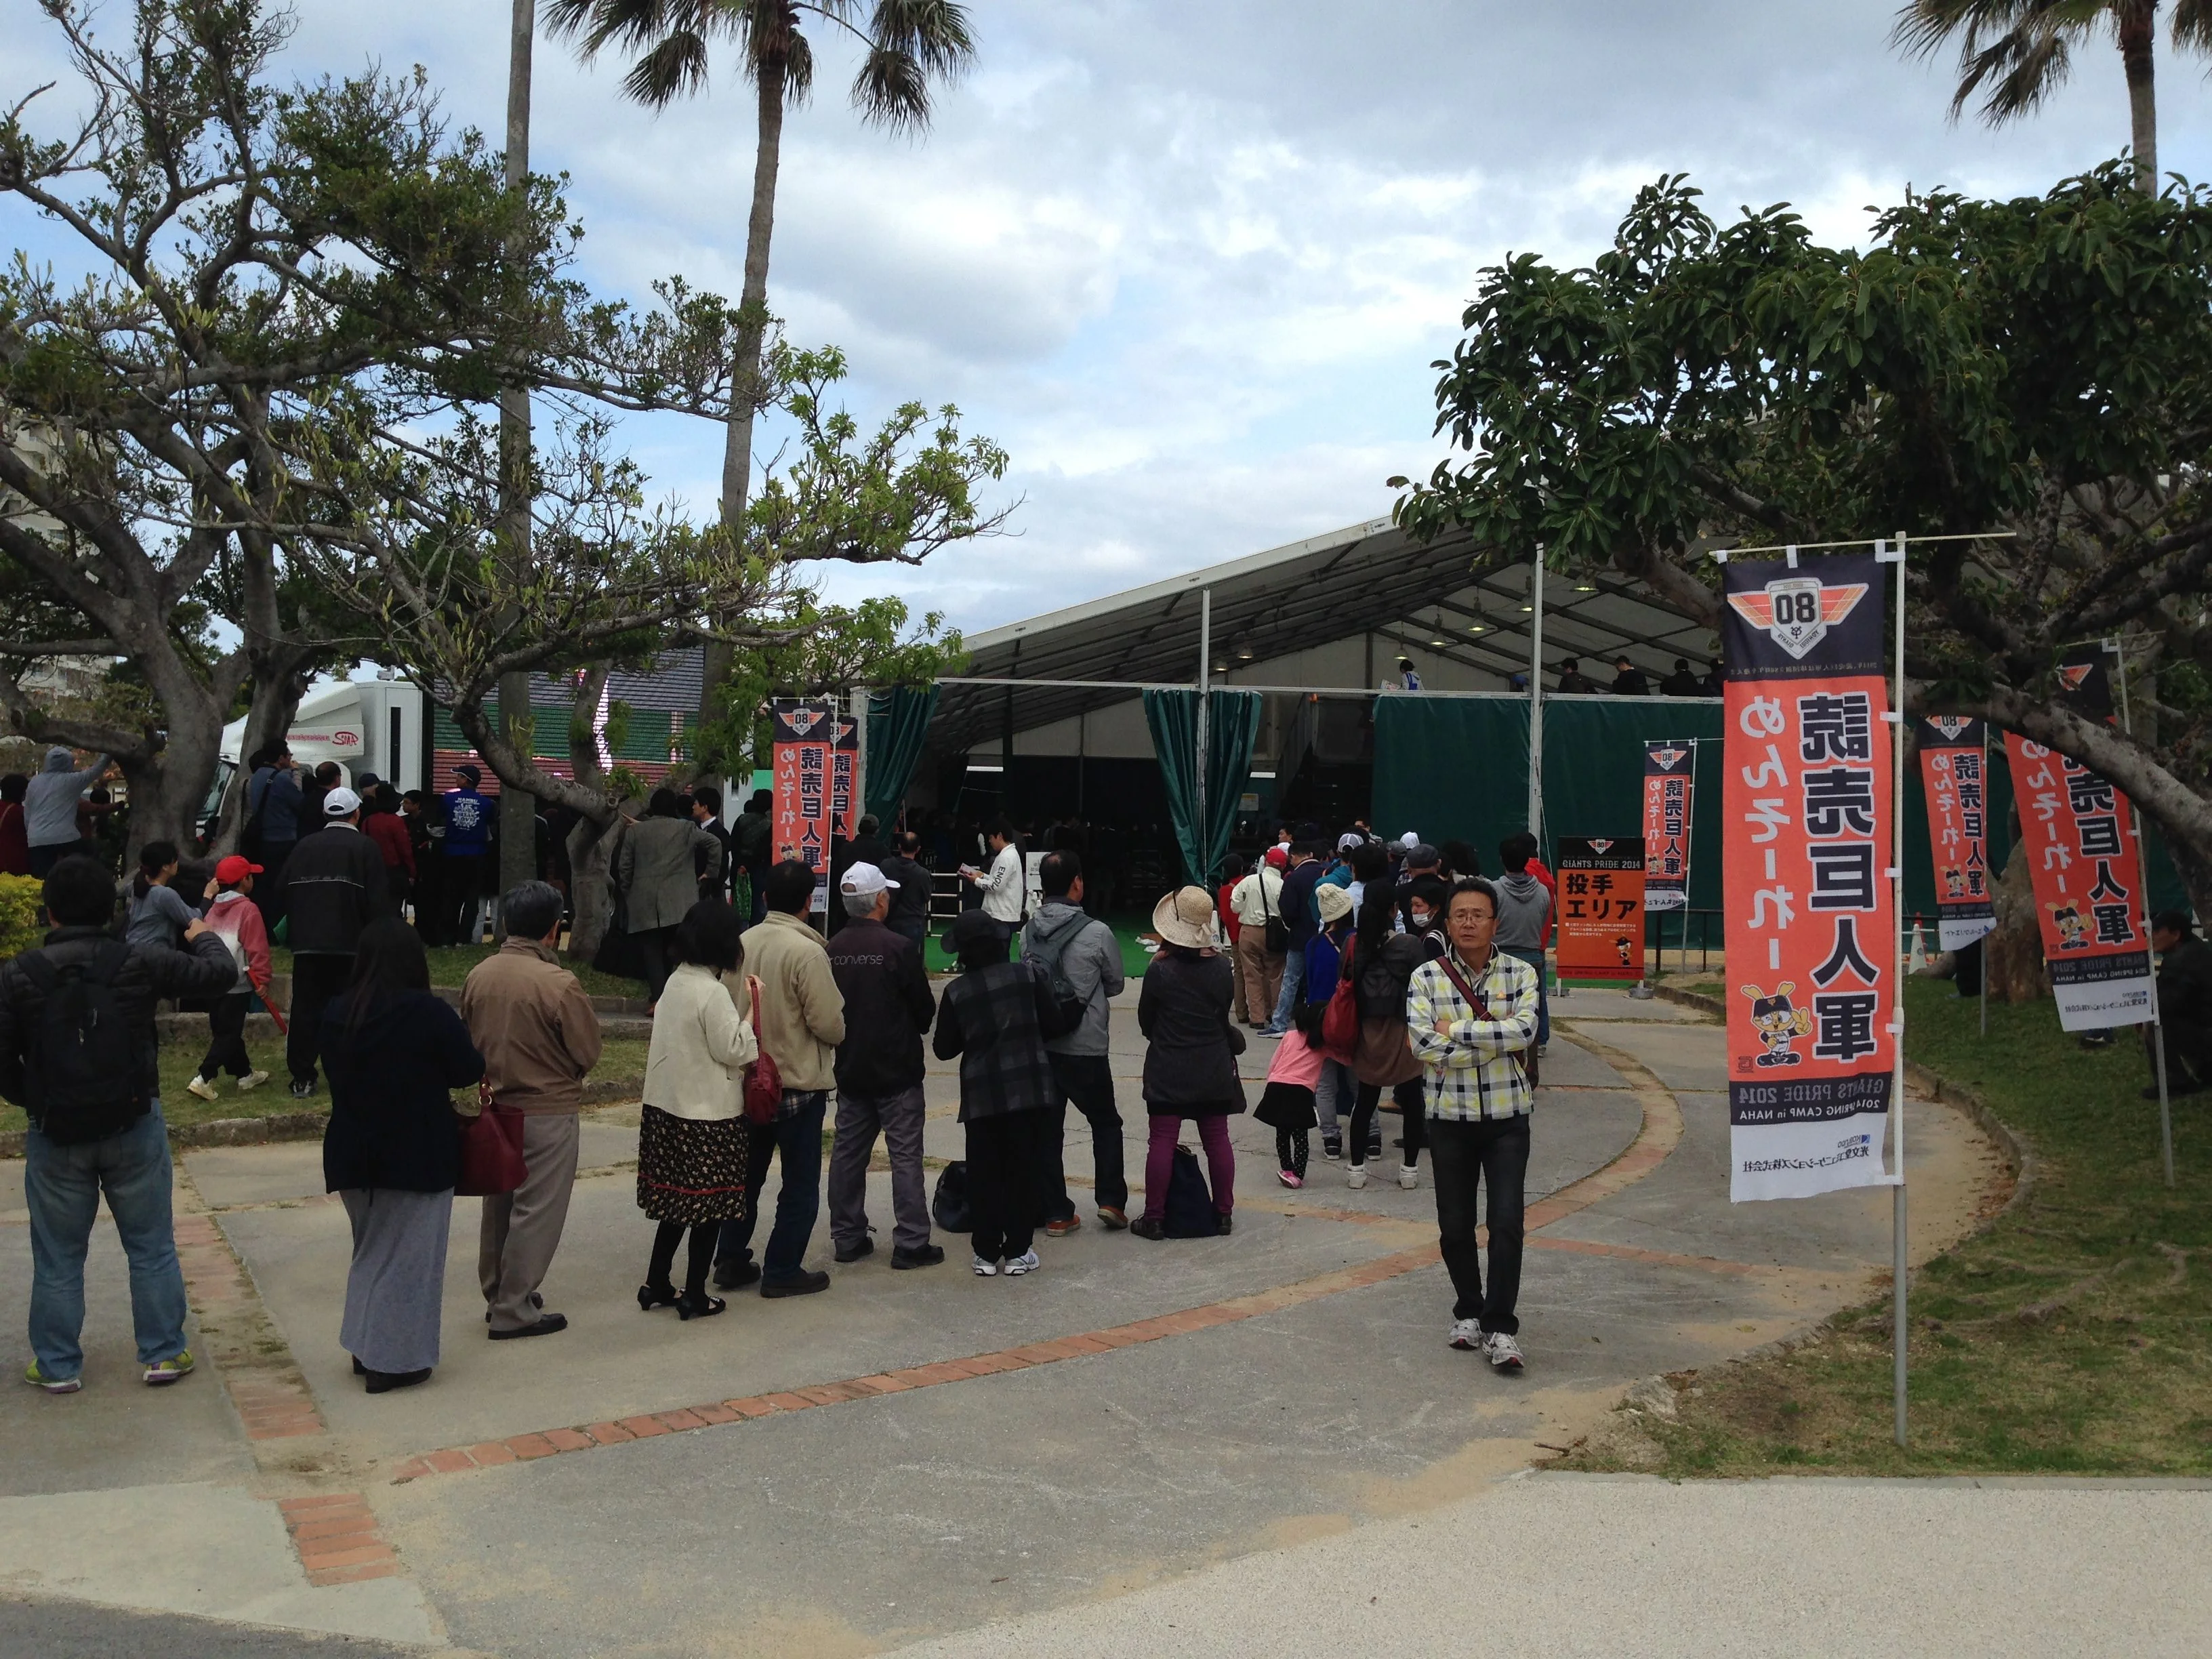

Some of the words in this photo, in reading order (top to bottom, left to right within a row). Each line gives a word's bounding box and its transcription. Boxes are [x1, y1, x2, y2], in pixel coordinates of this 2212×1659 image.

[1562, 859, 1592, 868] GIANTS
[1595, 860, 1619, 869] PRIDE
[1622, 860, 1641, 869] 2014
[1566, 873, 1614, 895] 投手
[1565, 899, 1637, 920] エリア
[834, 954, 884, 965] converse
